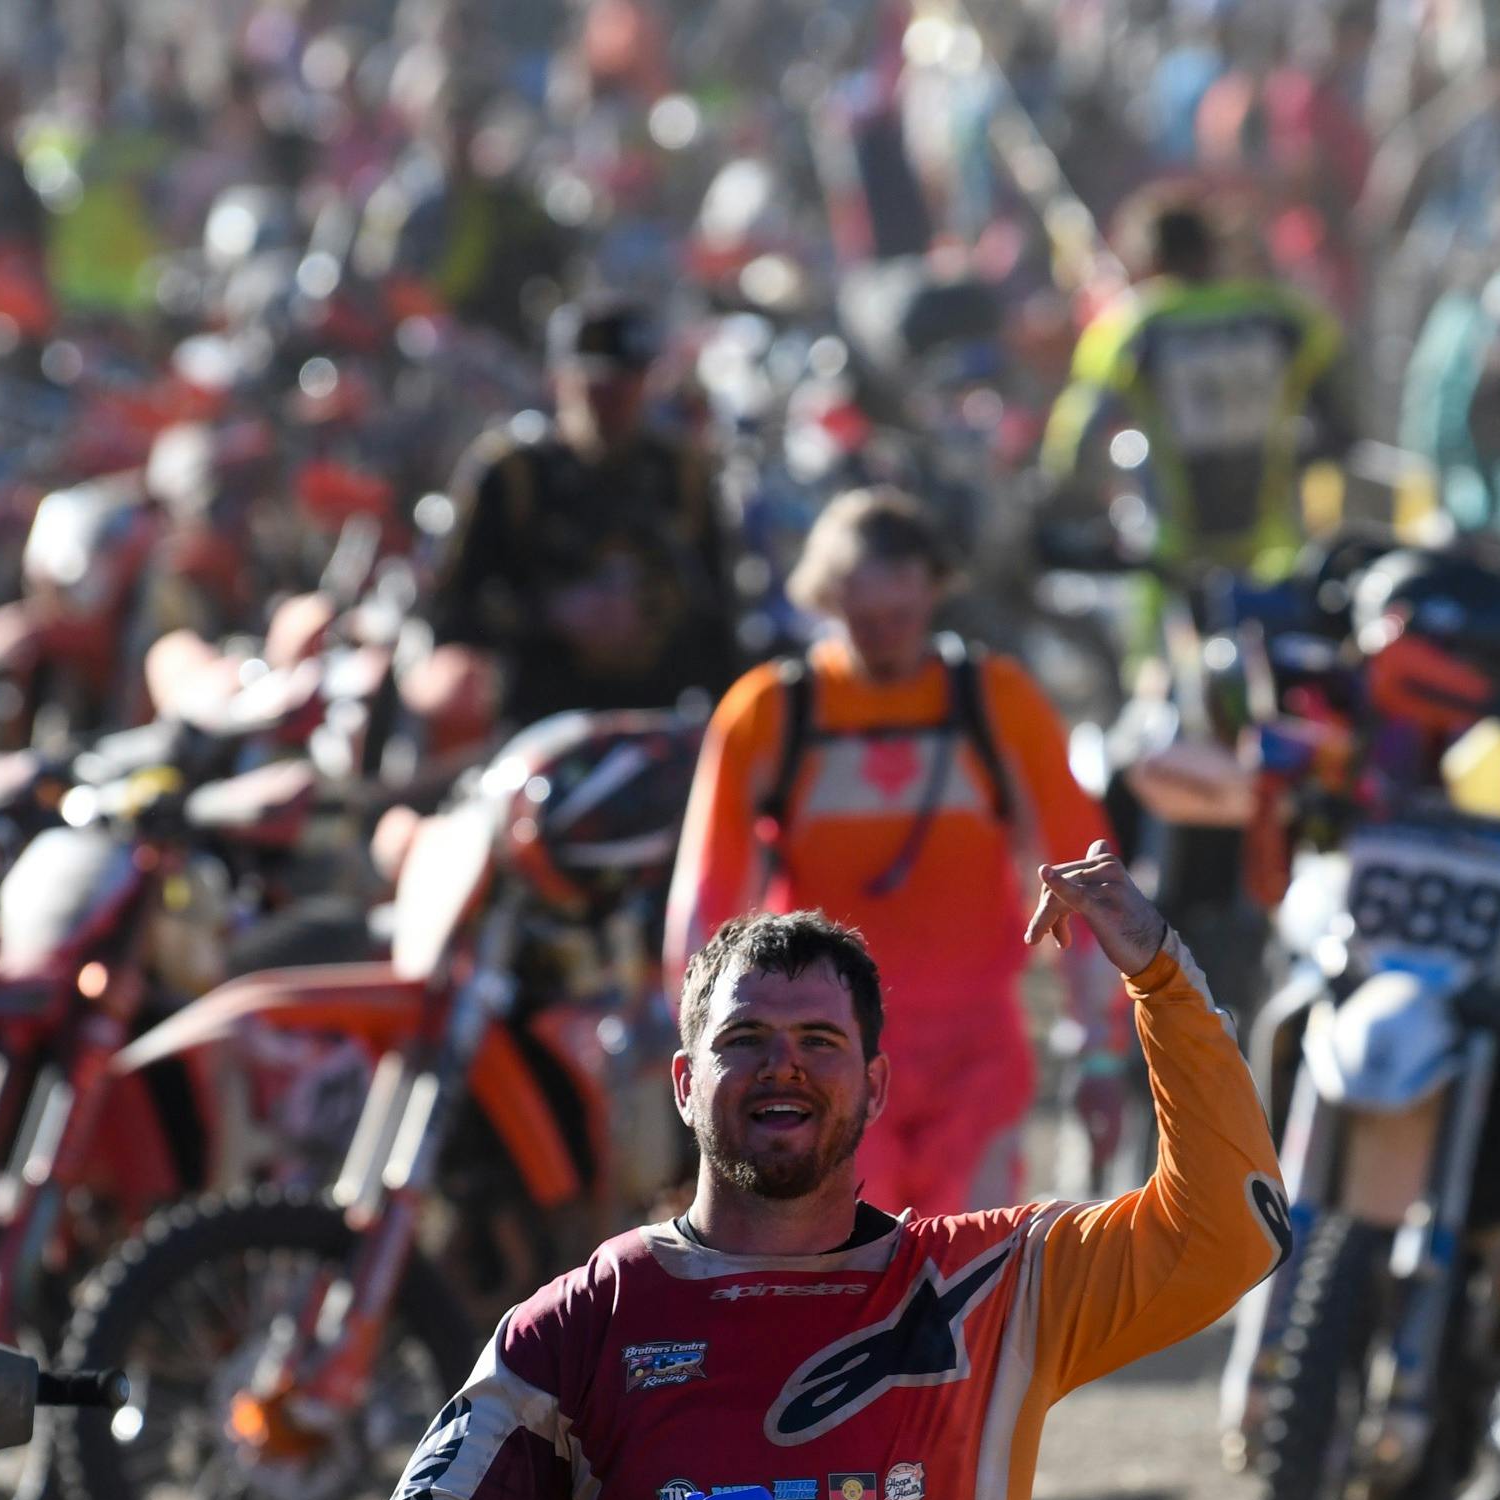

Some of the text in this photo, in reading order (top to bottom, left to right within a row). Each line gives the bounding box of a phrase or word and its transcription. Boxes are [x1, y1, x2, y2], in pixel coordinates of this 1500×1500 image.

[710, 1282, 868, 1301] alpinestars
[625, 1342, 706, 1359] Brothers Centre
[643, 1374, 688, 1387] Racing
